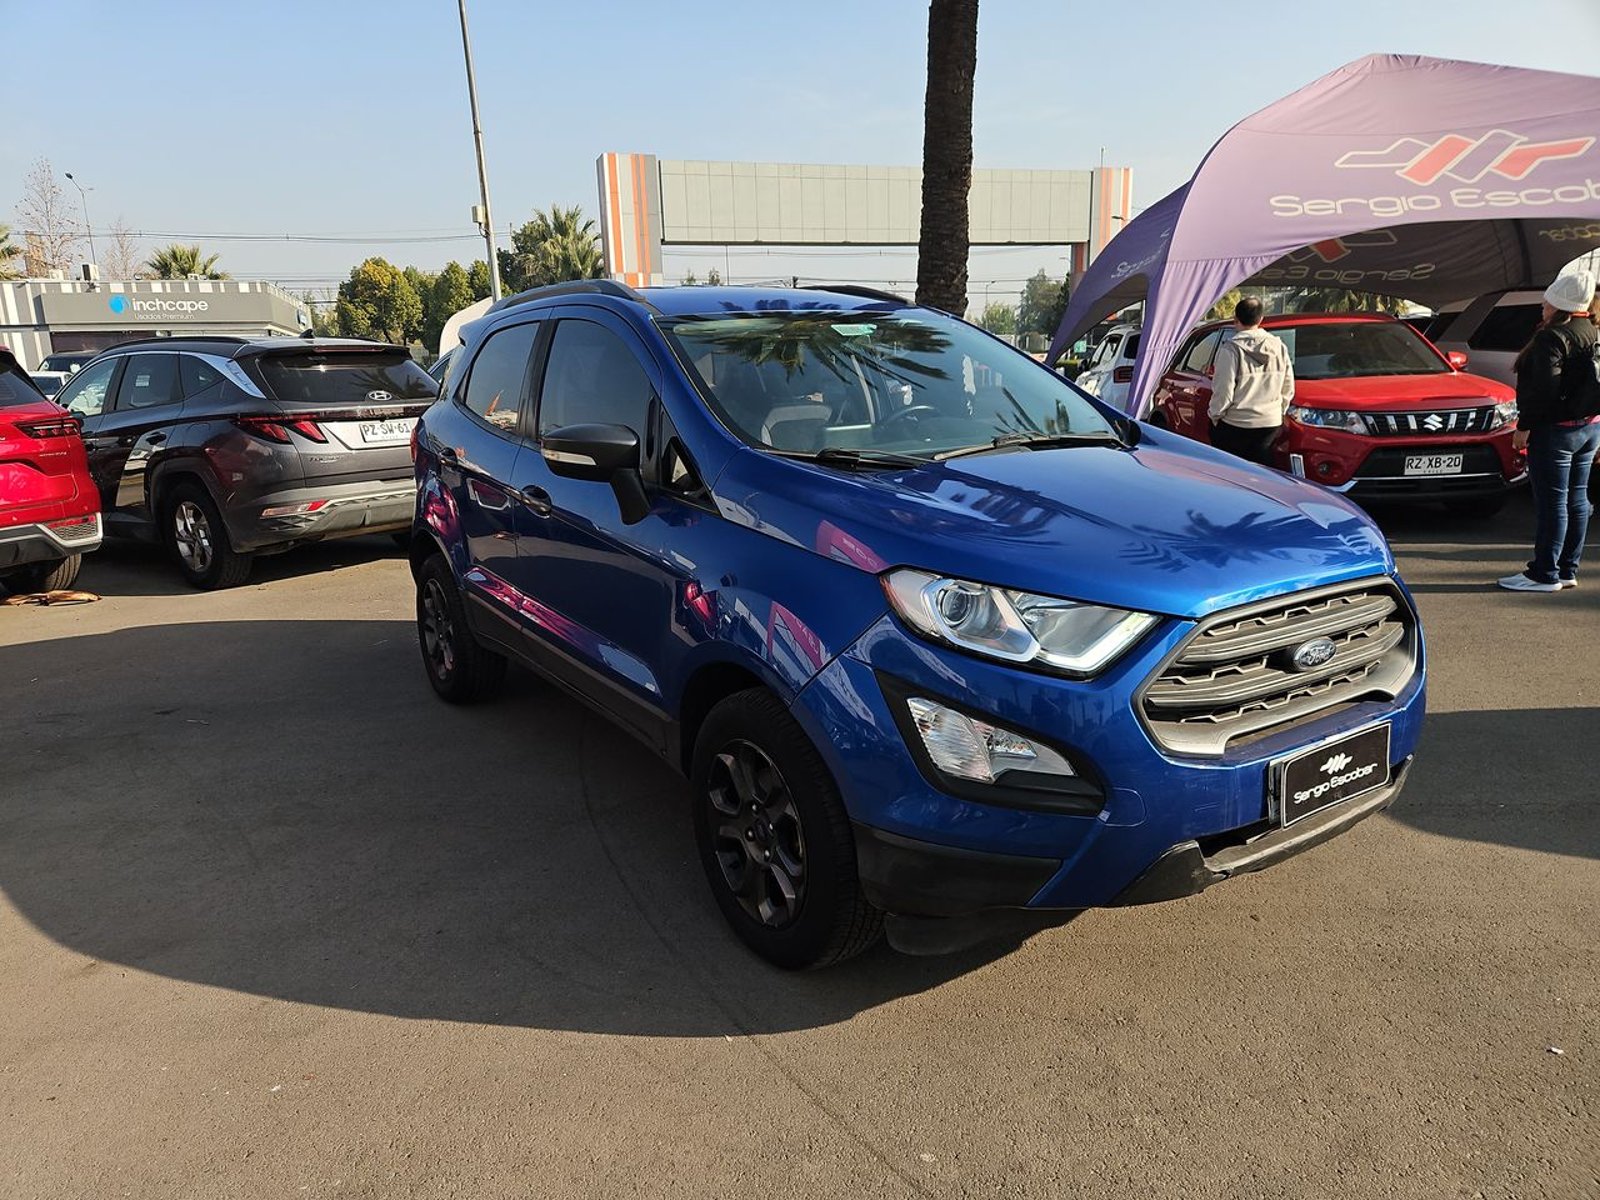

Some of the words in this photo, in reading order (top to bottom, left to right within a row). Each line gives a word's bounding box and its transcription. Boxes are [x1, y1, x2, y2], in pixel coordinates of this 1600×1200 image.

[1269, 195, 1441, 217] Sergio
[132, 298, 209, 313] inchcape
[1330, 763, 1378, 788] Escobar
